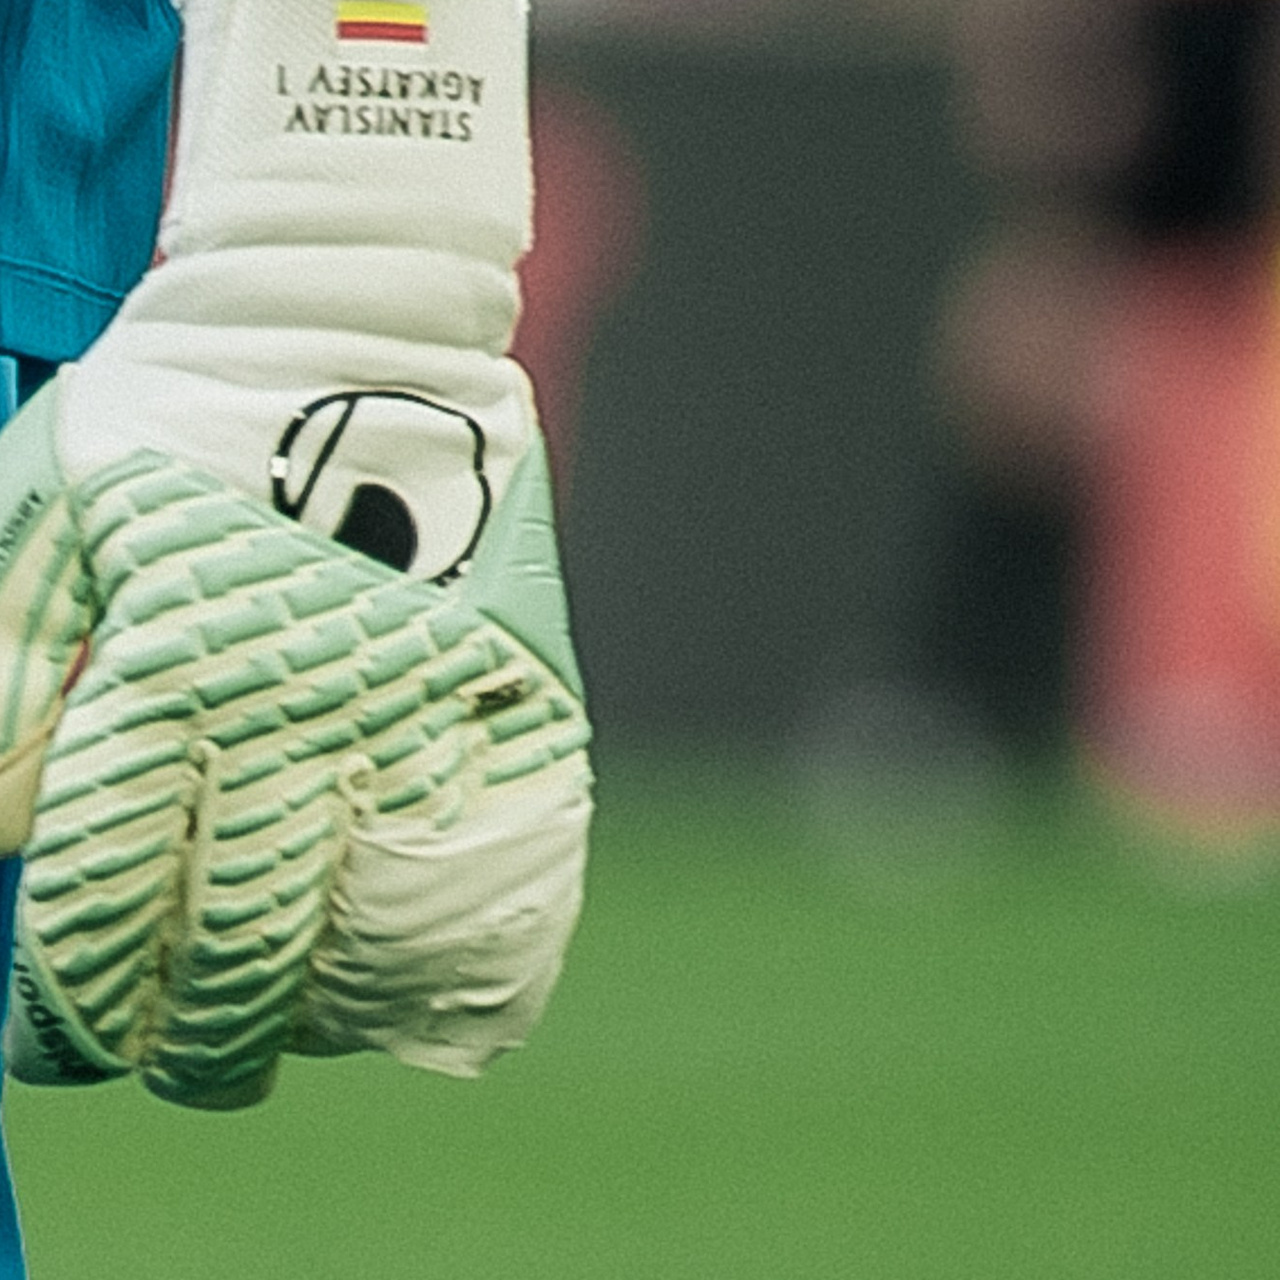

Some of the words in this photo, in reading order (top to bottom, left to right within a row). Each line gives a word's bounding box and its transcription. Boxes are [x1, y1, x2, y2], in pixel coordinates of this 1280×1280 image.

[276, 63, 289, 96] 1
[307, 63, 483, 106] AGKATSEV
[284, 103, 473, 142] STANISLAV
